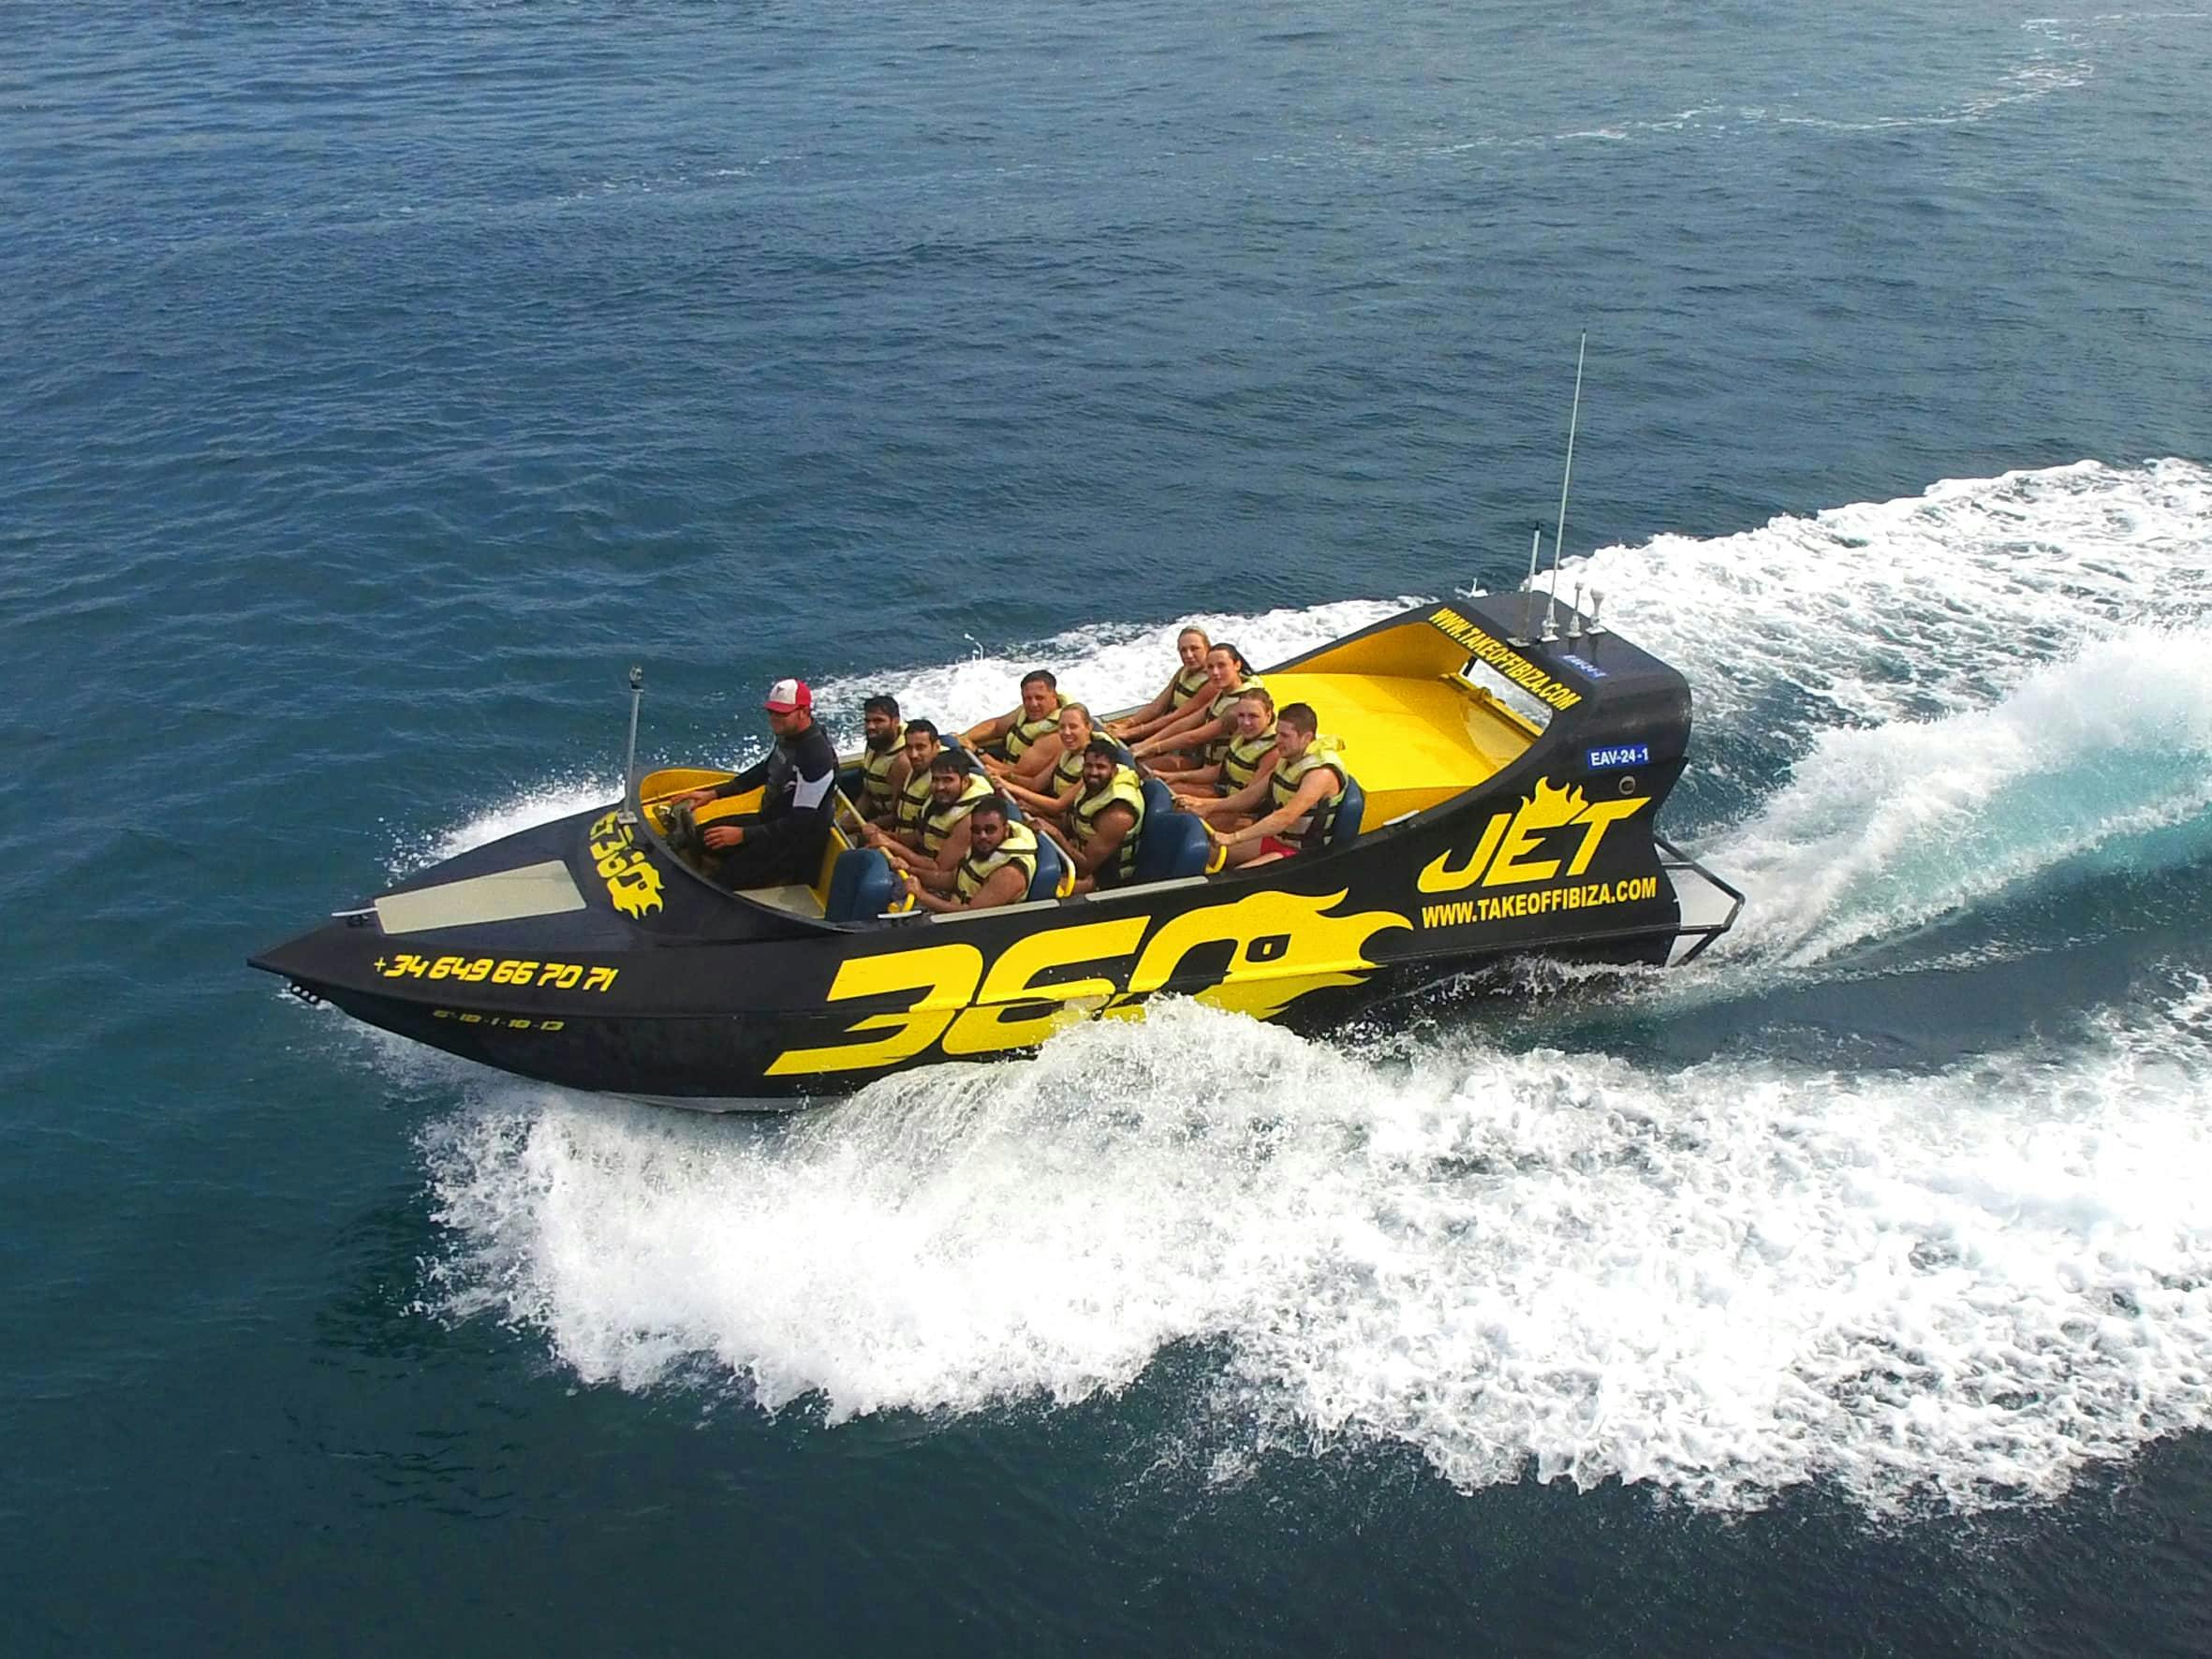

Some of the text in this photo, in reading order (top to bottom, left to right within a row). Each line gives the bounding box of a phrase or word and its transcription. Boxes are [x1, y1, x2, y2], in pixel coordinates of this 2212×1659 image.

[1428, 608, 1582, 711] WWW.TAKEOFFIBIZA.COM
[1590, 747, 1649, 767] EAV-24-1
[1417, 777, 1651, 893] JET
[1422, 877, 1657, 929] WWW.TAKEOFFIBIZA.COM
[375, 954, 619, 992] +34 649 66 70 71
